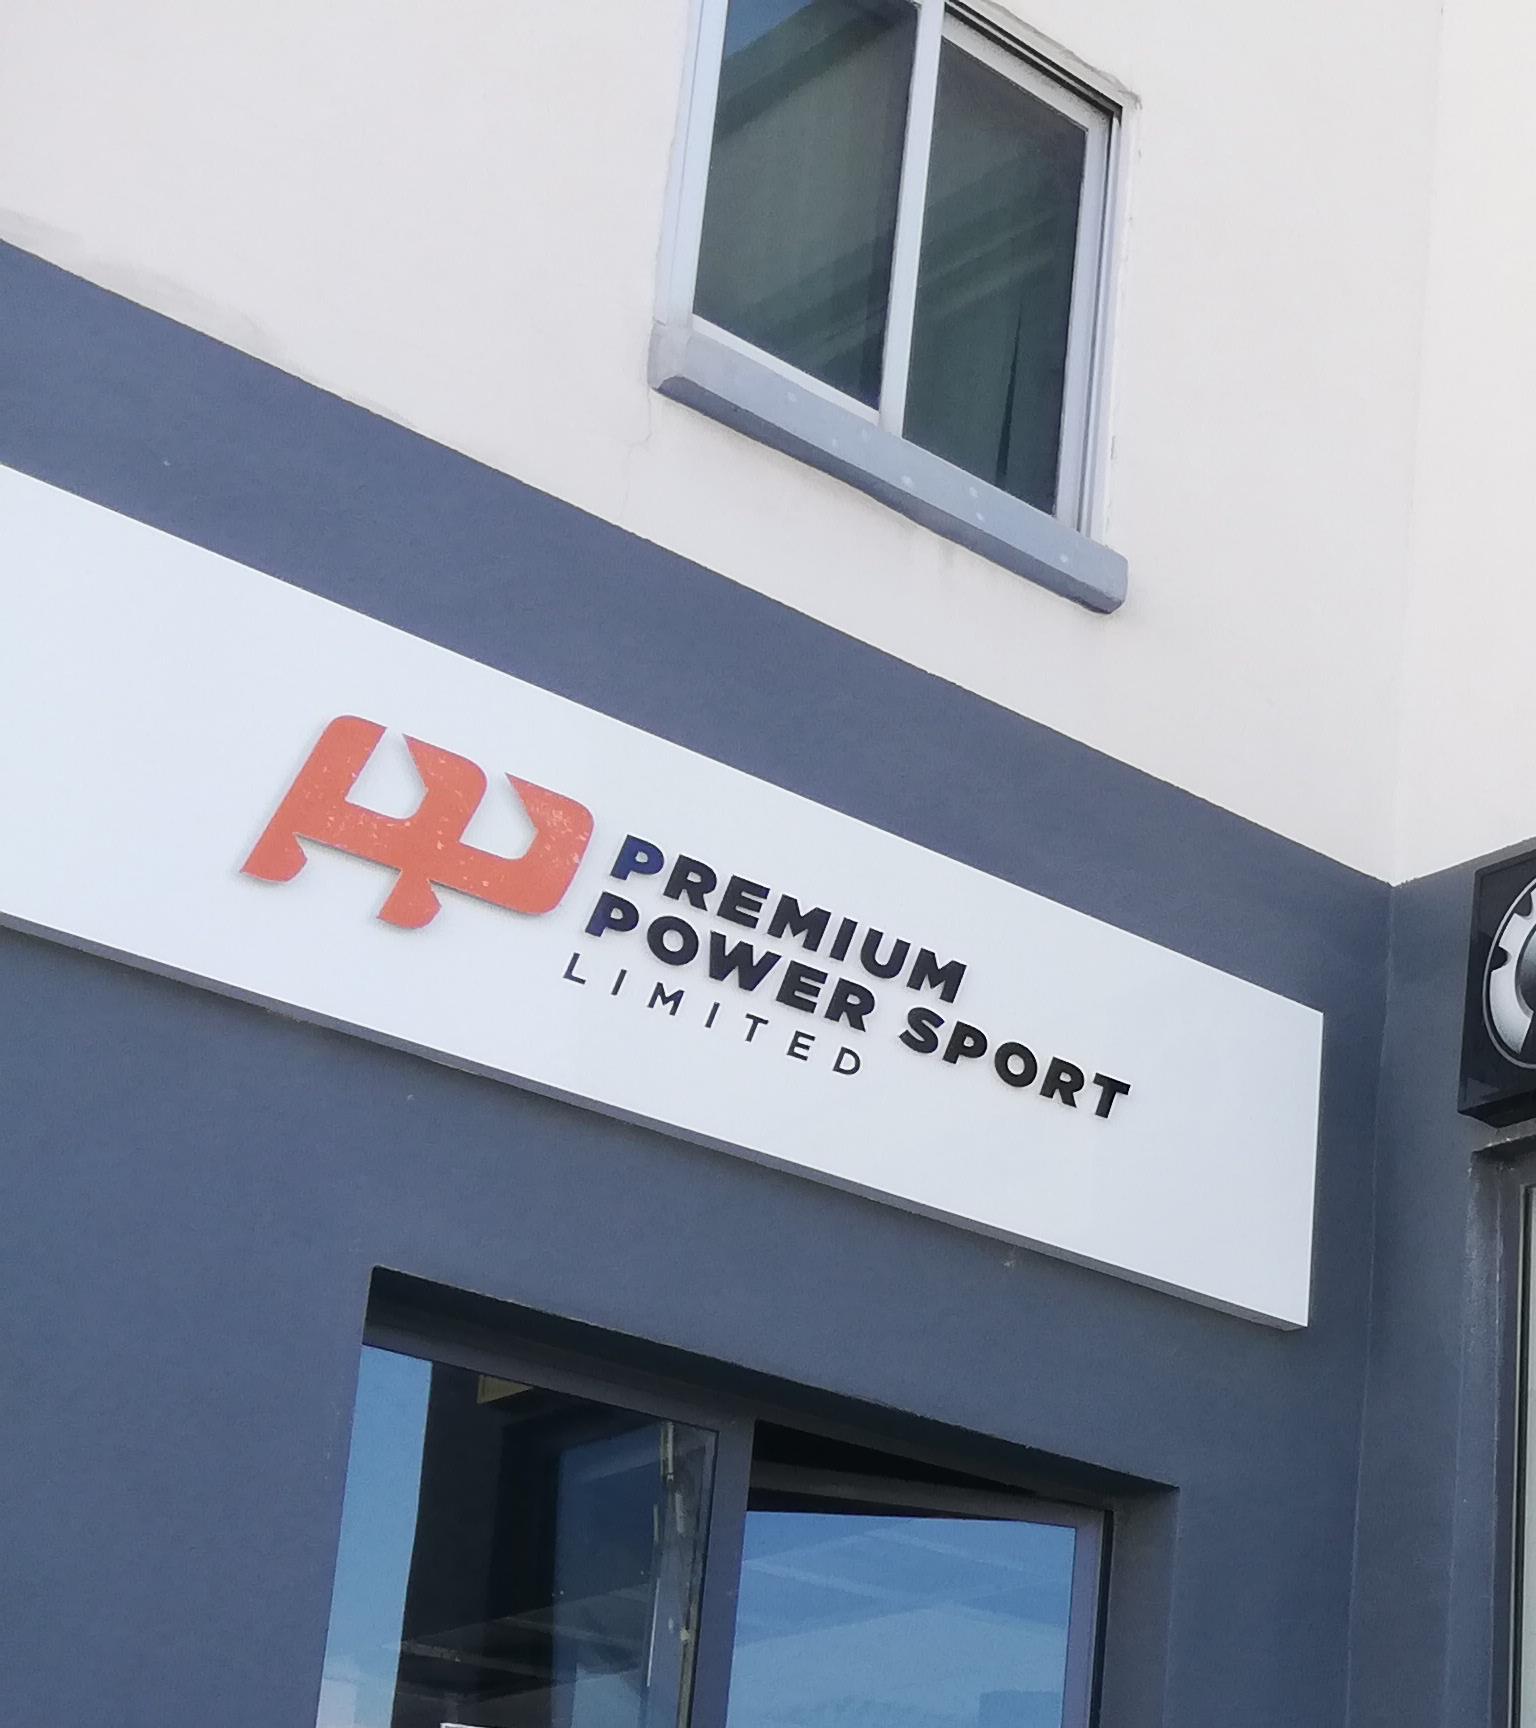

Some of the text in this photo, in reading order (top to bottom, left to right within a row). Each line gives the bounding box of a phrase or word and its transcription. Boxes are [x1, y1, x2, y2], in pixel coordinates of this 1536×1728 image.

[608, 834, 967, 1003] PREMIUM
[562, 951, 863, 1076] LIMITED
[584, 892, 1131, 1119] POWER SPORT
